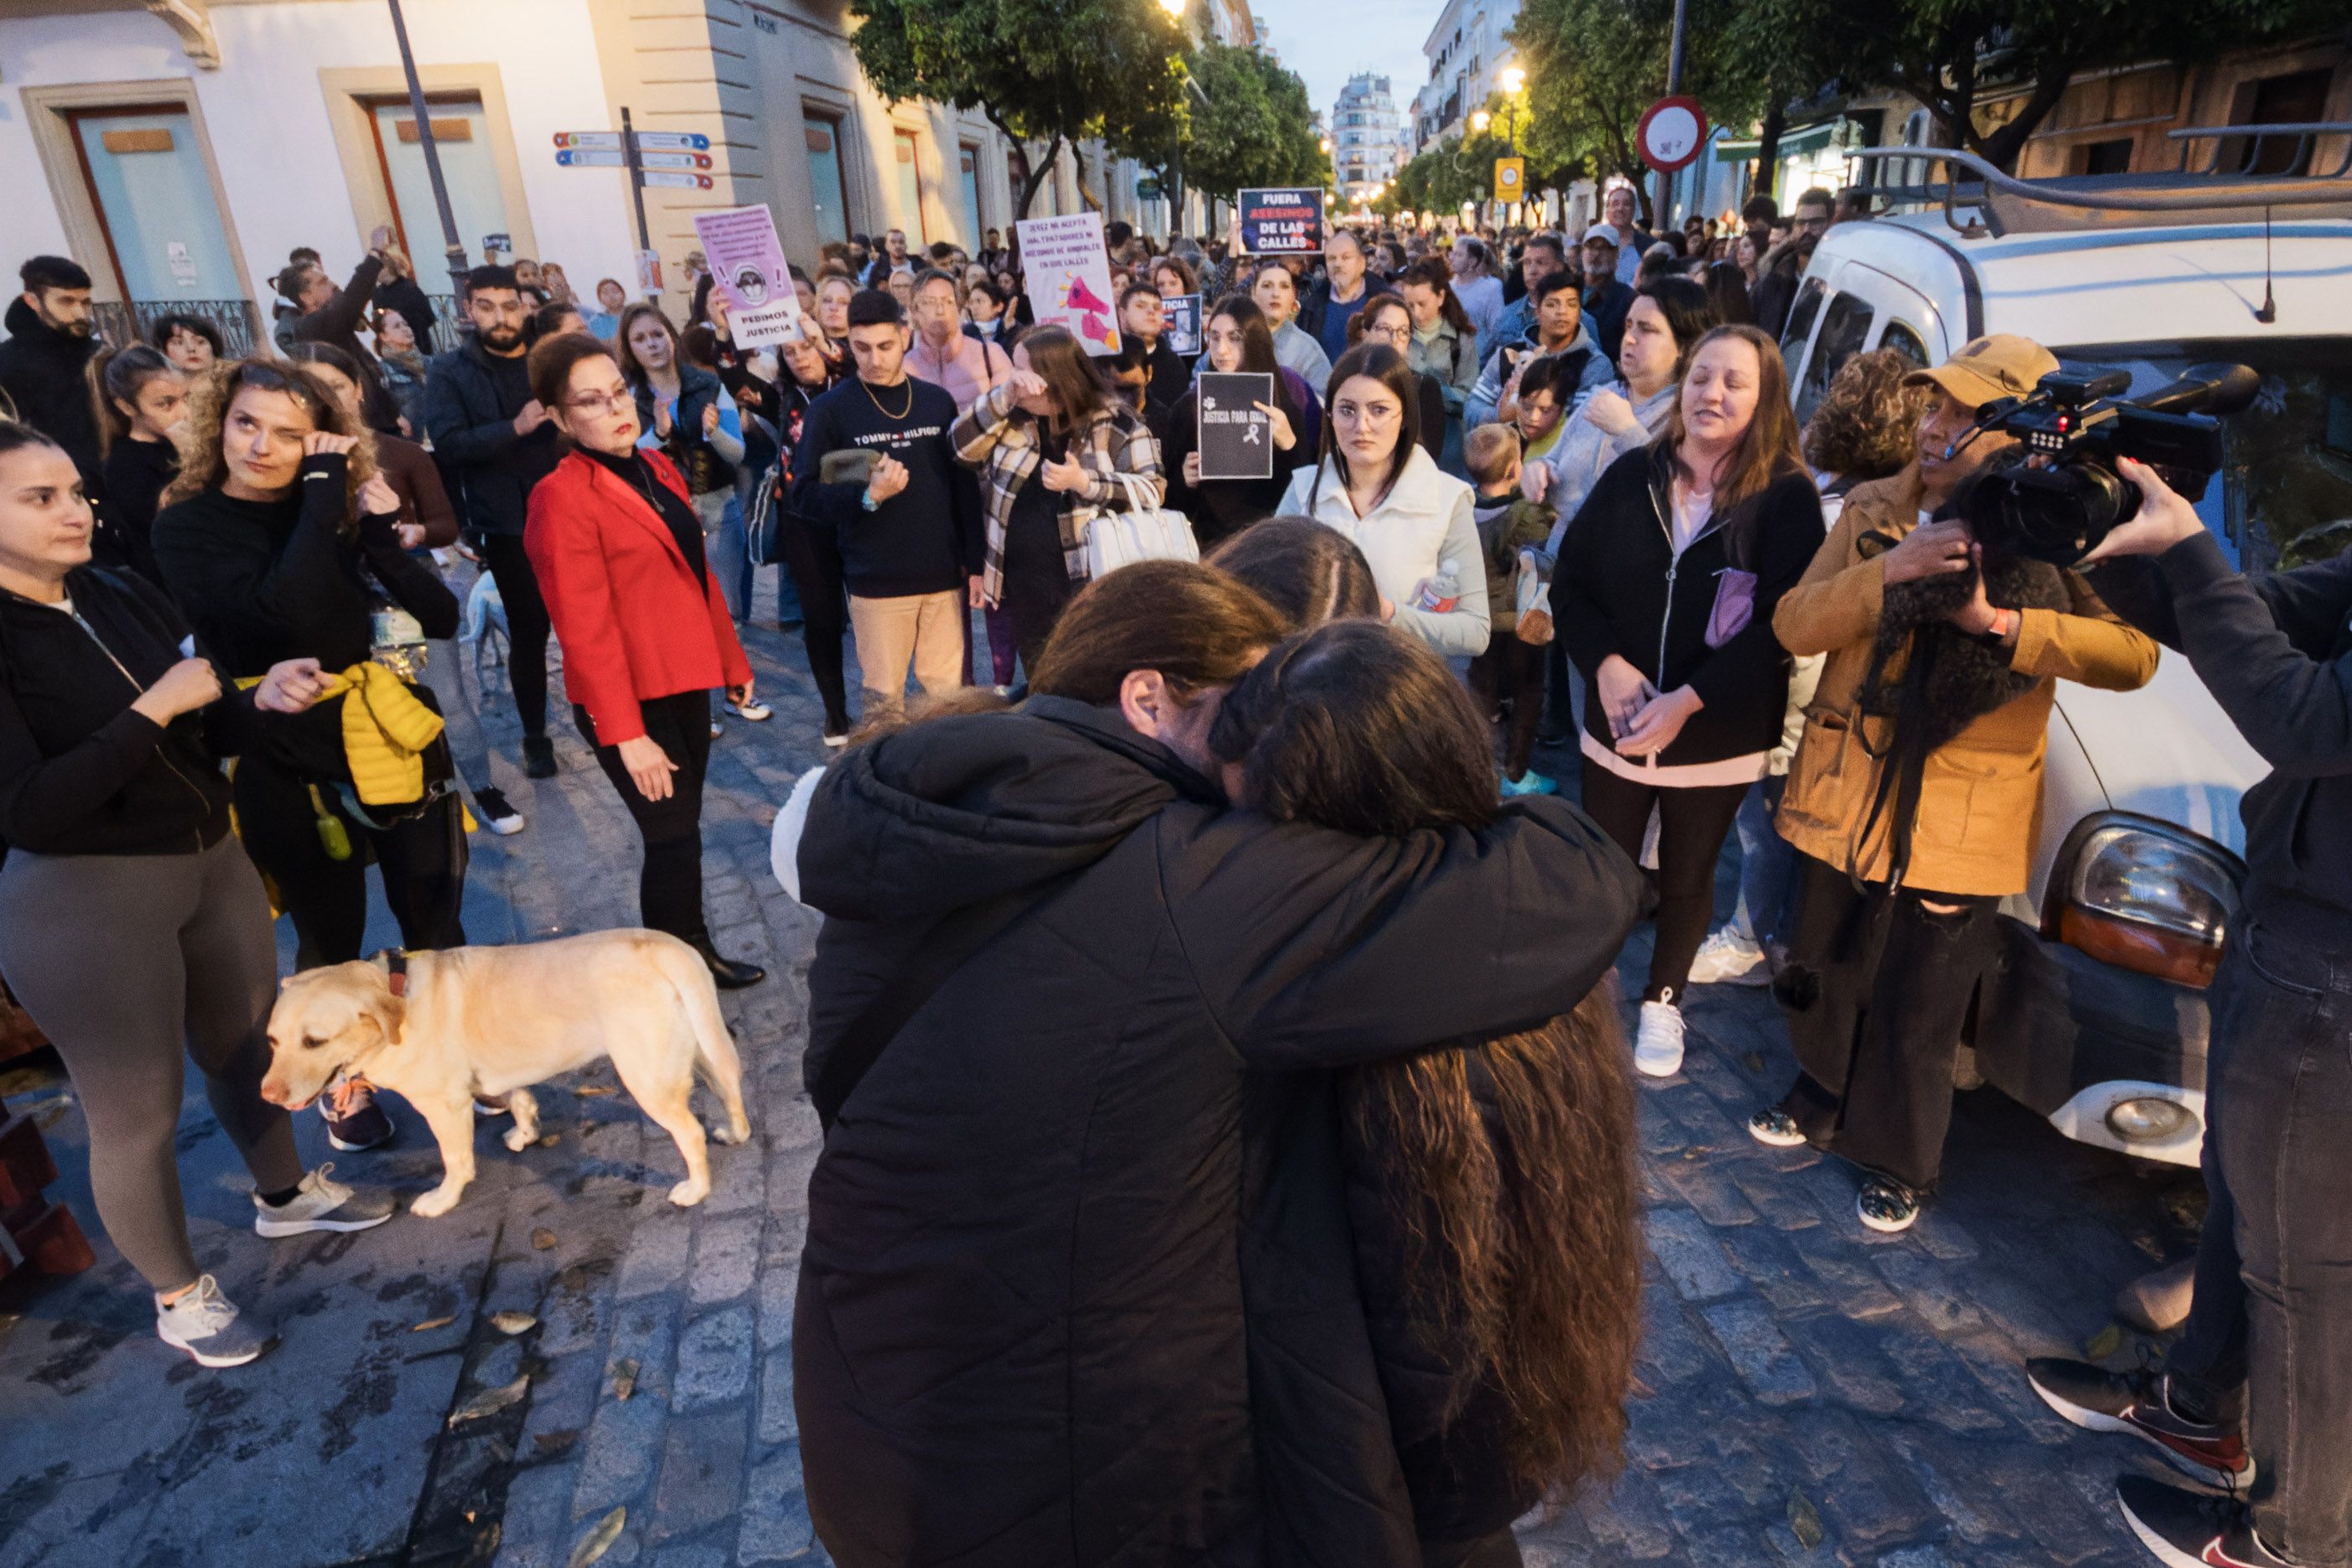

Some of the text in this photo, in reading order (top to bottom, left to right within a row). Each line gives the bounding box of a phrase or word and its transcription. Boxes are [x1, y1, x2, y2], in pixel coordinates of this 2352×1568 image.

[1263, 194, 1301, 205] FUERA
[1259, 221, 1305, 234] DE LAS
[1258, 236, 1306, 249] CALLES
[1162, 299, 1188, 309] TICIA
[741, 310, 788, 325] PEDIMOS
[746, 325, 792, 337] JUSTICIA
[854, 433, 891, 446] TOMMY
